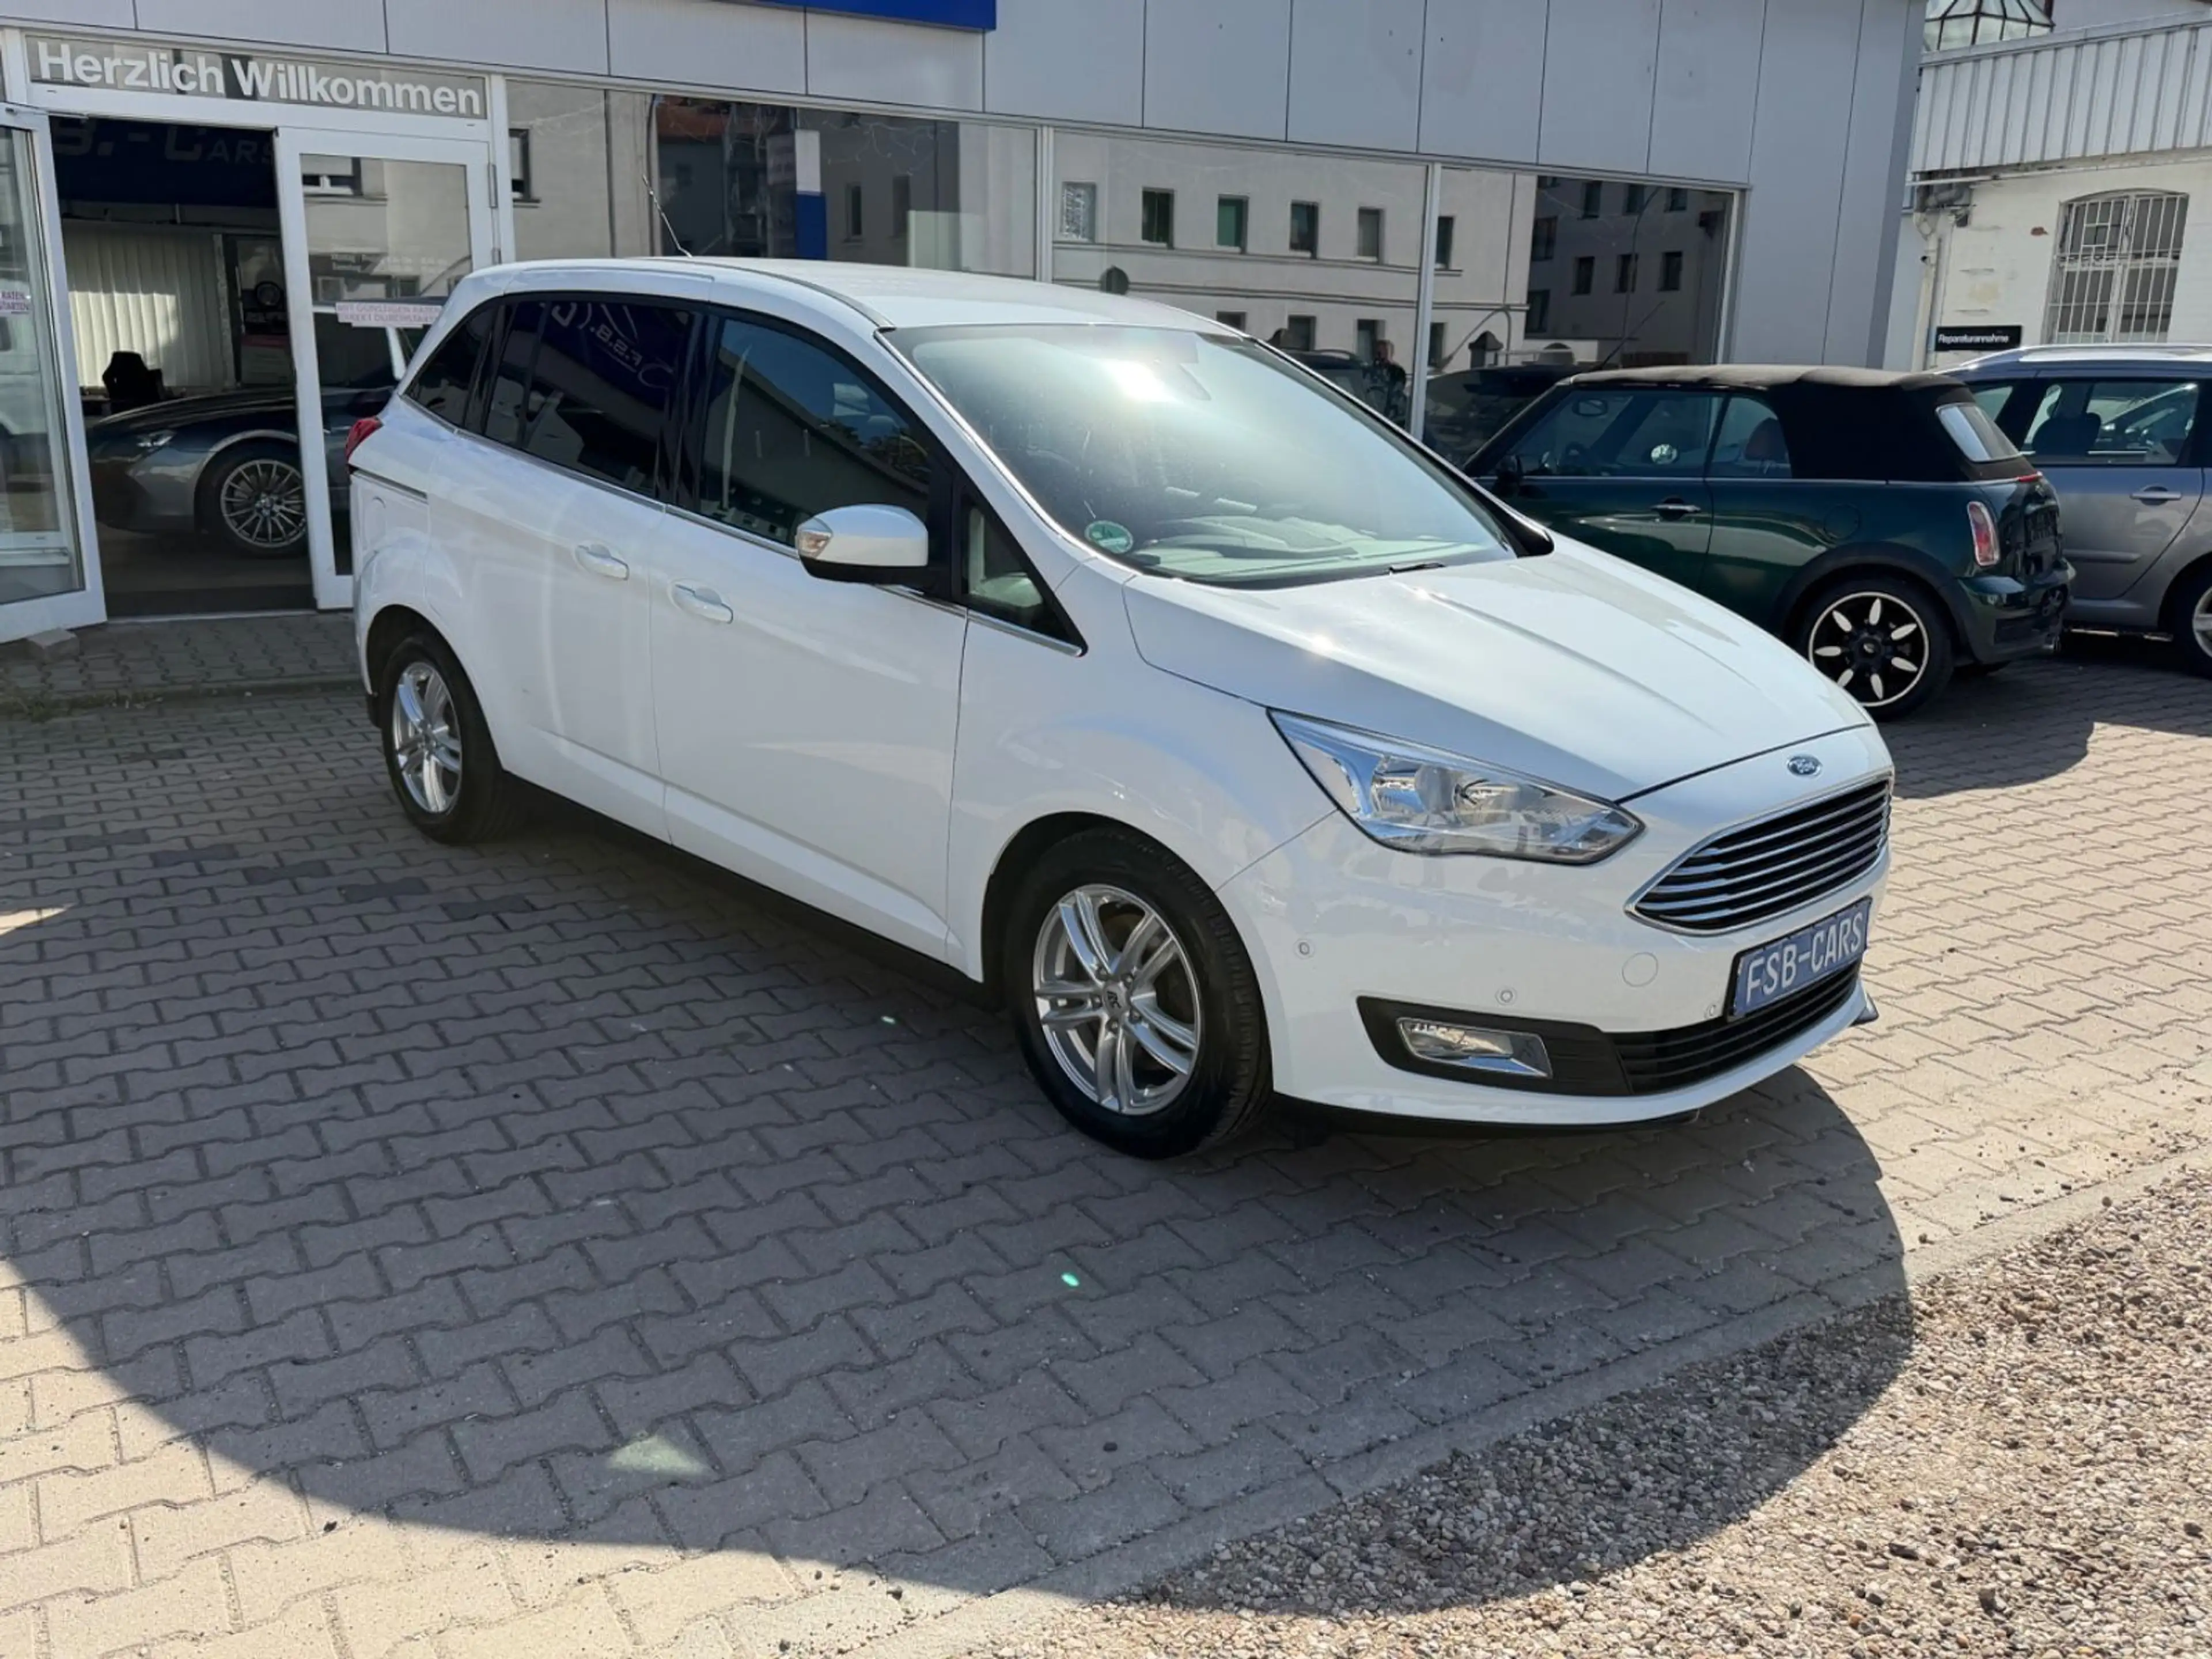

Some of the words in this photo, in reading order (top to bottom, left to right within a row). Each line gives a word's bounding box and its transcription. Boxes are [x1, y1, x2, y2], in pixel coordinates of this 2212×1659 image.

[37, 41, 226, 94] Herzlich
[230, 59, 482, 115] Willkommen
[1746, 912, 1863, 1006] FSB-CARS
